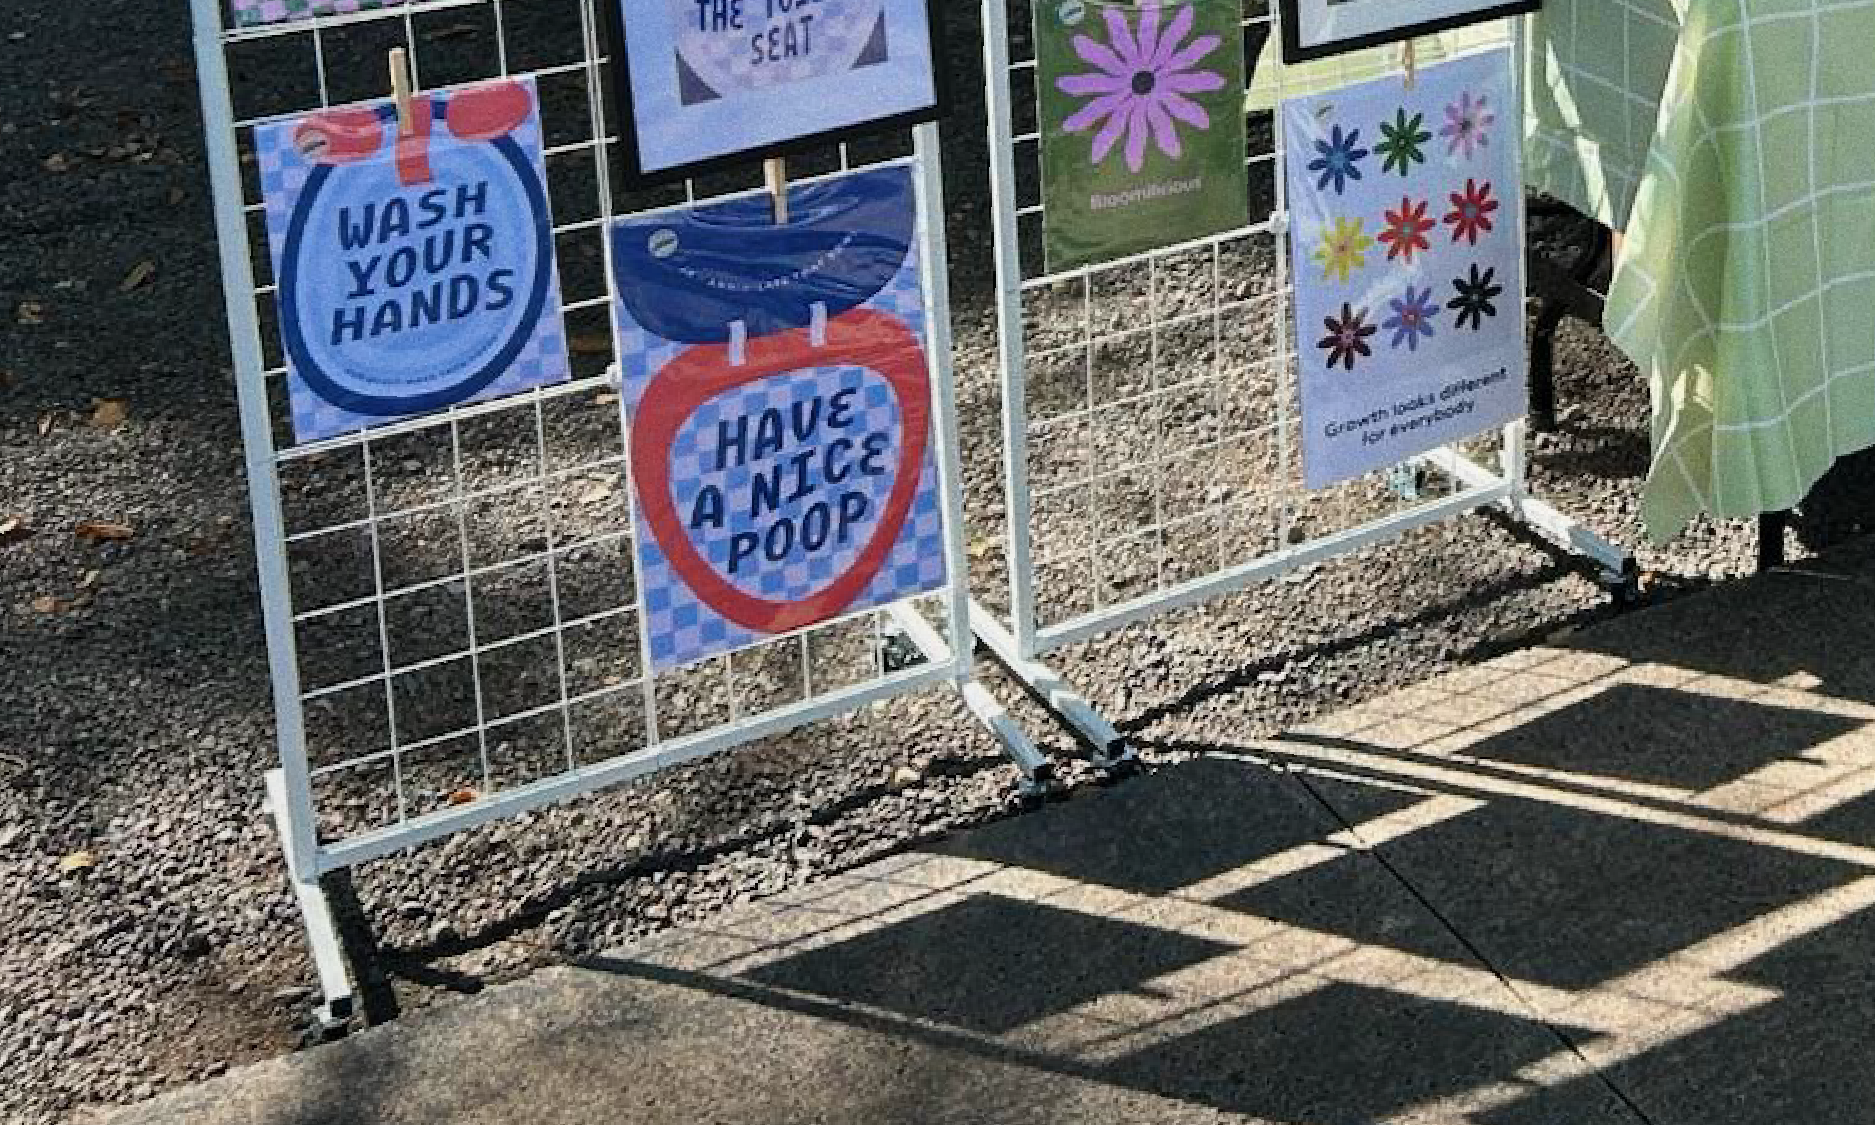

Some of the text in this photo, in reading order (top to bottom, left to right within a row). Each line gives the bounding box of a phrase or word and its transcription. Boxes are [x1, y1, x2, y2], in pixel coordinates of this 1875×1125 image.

[751, 15, 815, 65] SEAT
[337, 181, 489, 251] WASH
[346, 223, 494, 299] YOUR
[331, 268, 514, 345] HANDS
[714, 386, 861, 472] HAVE
[1324, 367, 1507, 438] Growth looks different
[1361, 398, 1475, 447] for everybody
[691, 432, 891, 530] A NICE
[727, 491, 869, 574] POOP
